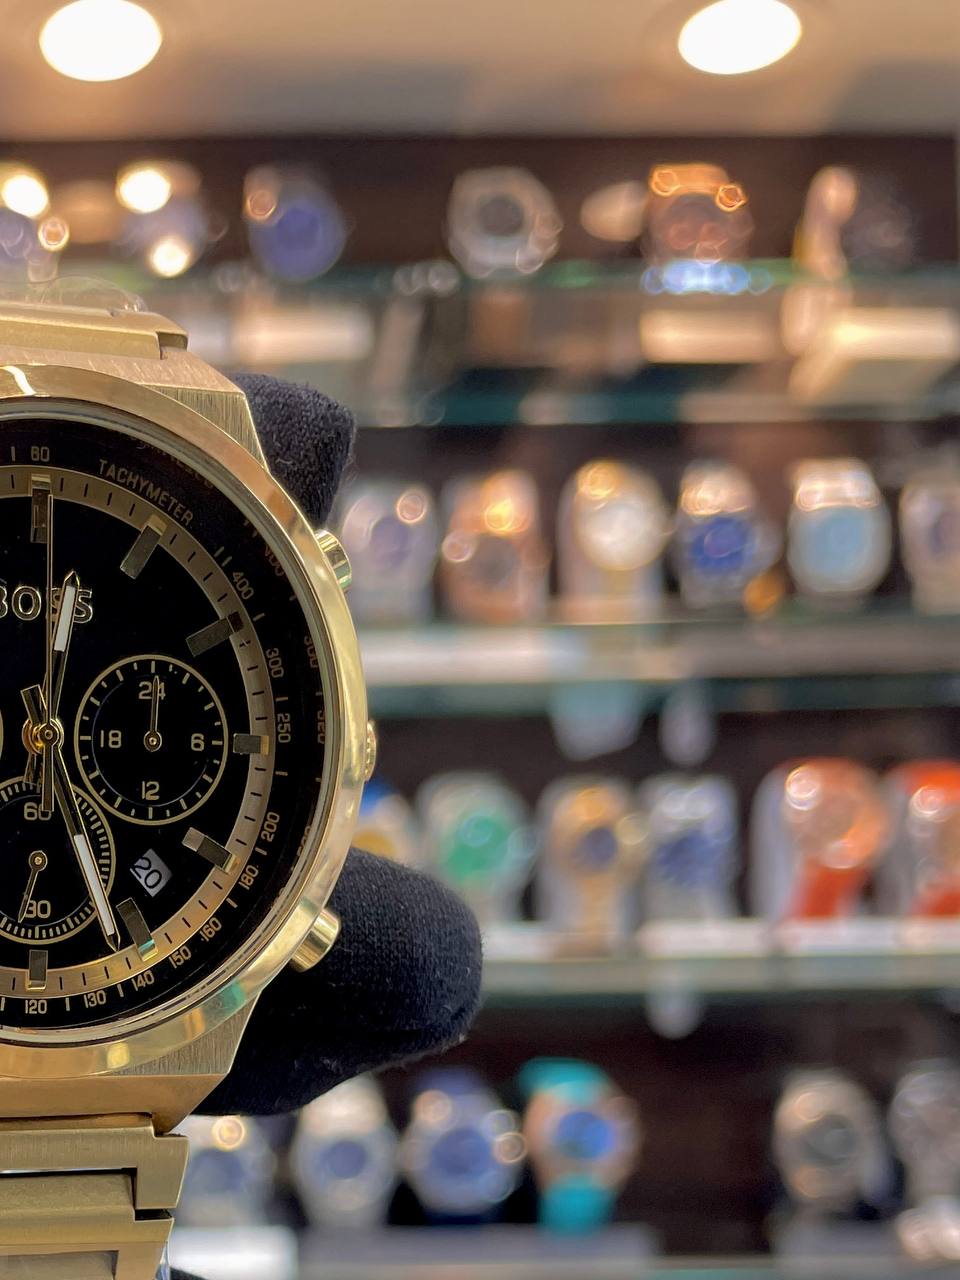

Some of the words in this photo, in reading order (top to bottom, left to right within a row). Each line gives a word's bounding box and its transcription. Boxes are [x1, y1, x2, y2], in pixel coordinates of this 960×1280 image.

[99, 459, 194, 525] TACHYMETER
[232, 571, 255, 600] 400
[266, 647, 285, 679] 300
[138, 681, 166, 700] 24
[276, 713, 291, 743] 250
[100, 730, 122, 749] 18
[190, 733, 205, 752] 6
[141, 781, 160, 800] 12
[23, 802, 52, 821] 60
[261, 811, 281, 842] 200
[132, 856, 162, 889] 20
[238, 864, 259, 890] 180
[26, 900, 52, 919] 30
[200, 917, 222, 942] 160
[168, 946, 192, 968] 150
[131, 972, 155, 992] 140
[25, 1000, 47, 1014] 120
[84, 989, 107, 1008] 130
